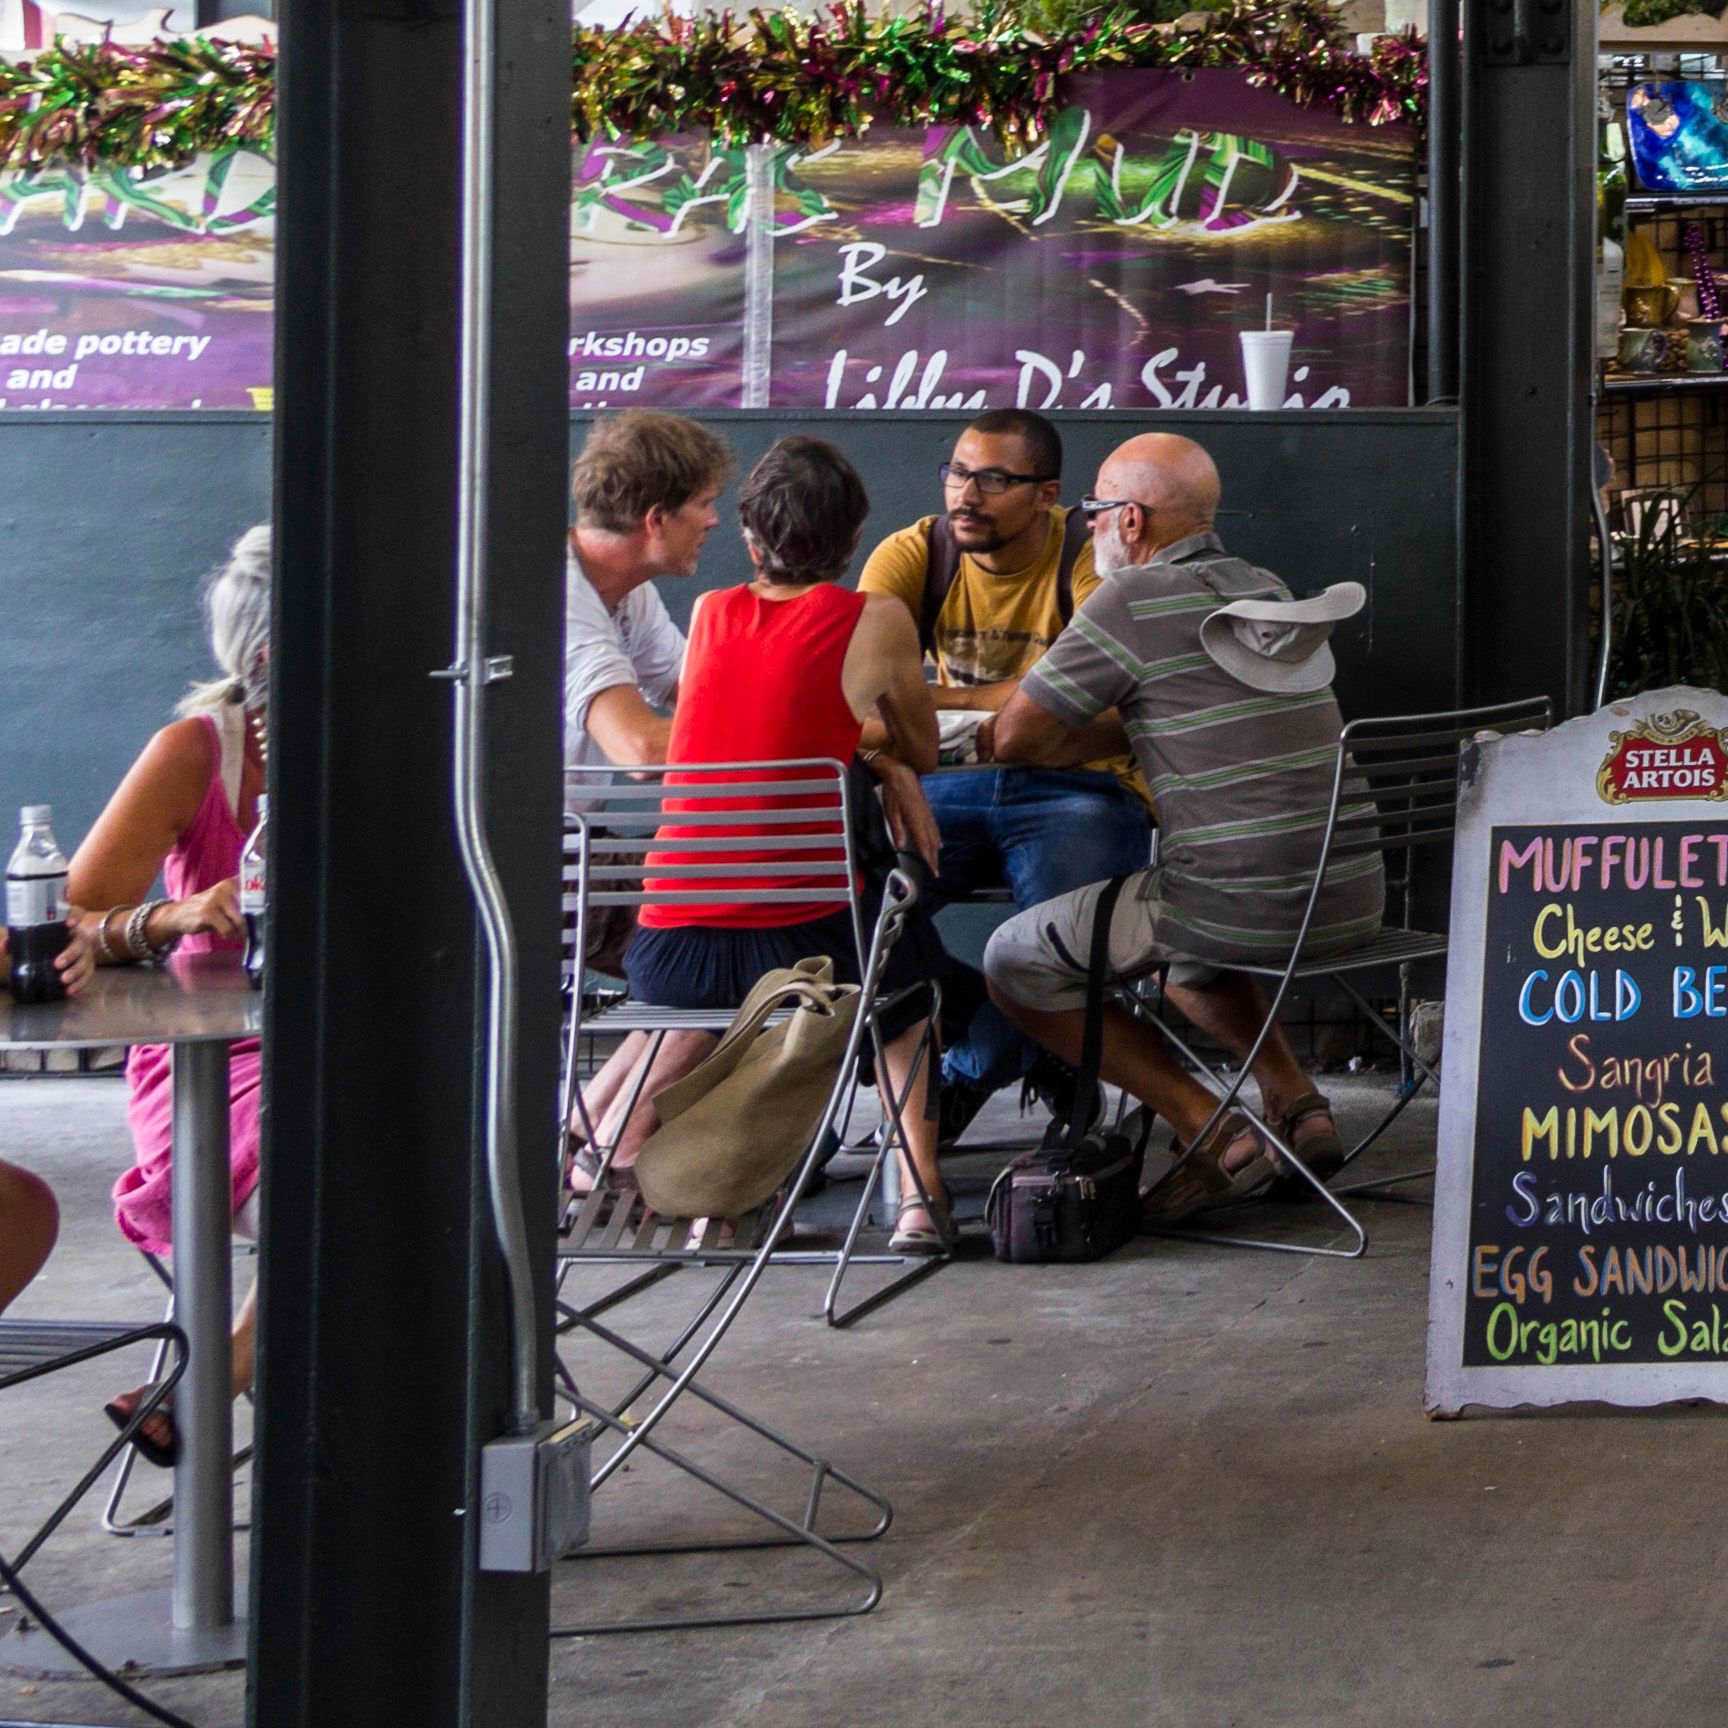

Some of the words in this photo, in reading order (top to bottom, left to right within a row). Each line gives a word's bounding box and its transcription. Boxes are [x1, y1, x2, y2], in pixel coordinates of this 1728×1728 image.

[838, 242, 927, 325] By
[0, 330, 66, 357] ade
[77, 330, 211, 360] pottery
[569, 331, 709, 359] rkshops
[7, 365, 79, 390] and
[576, 367, 643, 392] and
[1623, 768, 1716, 789] ARTOIS
[1625, 748, 1716, 768] STELLA
[1533, 903, 1655, 970] Cheese
[1518, 969, 1641, 1026] COLD
[1558, 1034, 1716, 1106] Sangria
[1471, 1243, 1553, 1303] EGG
[1487, 1302, 1632, 1366] Organic
